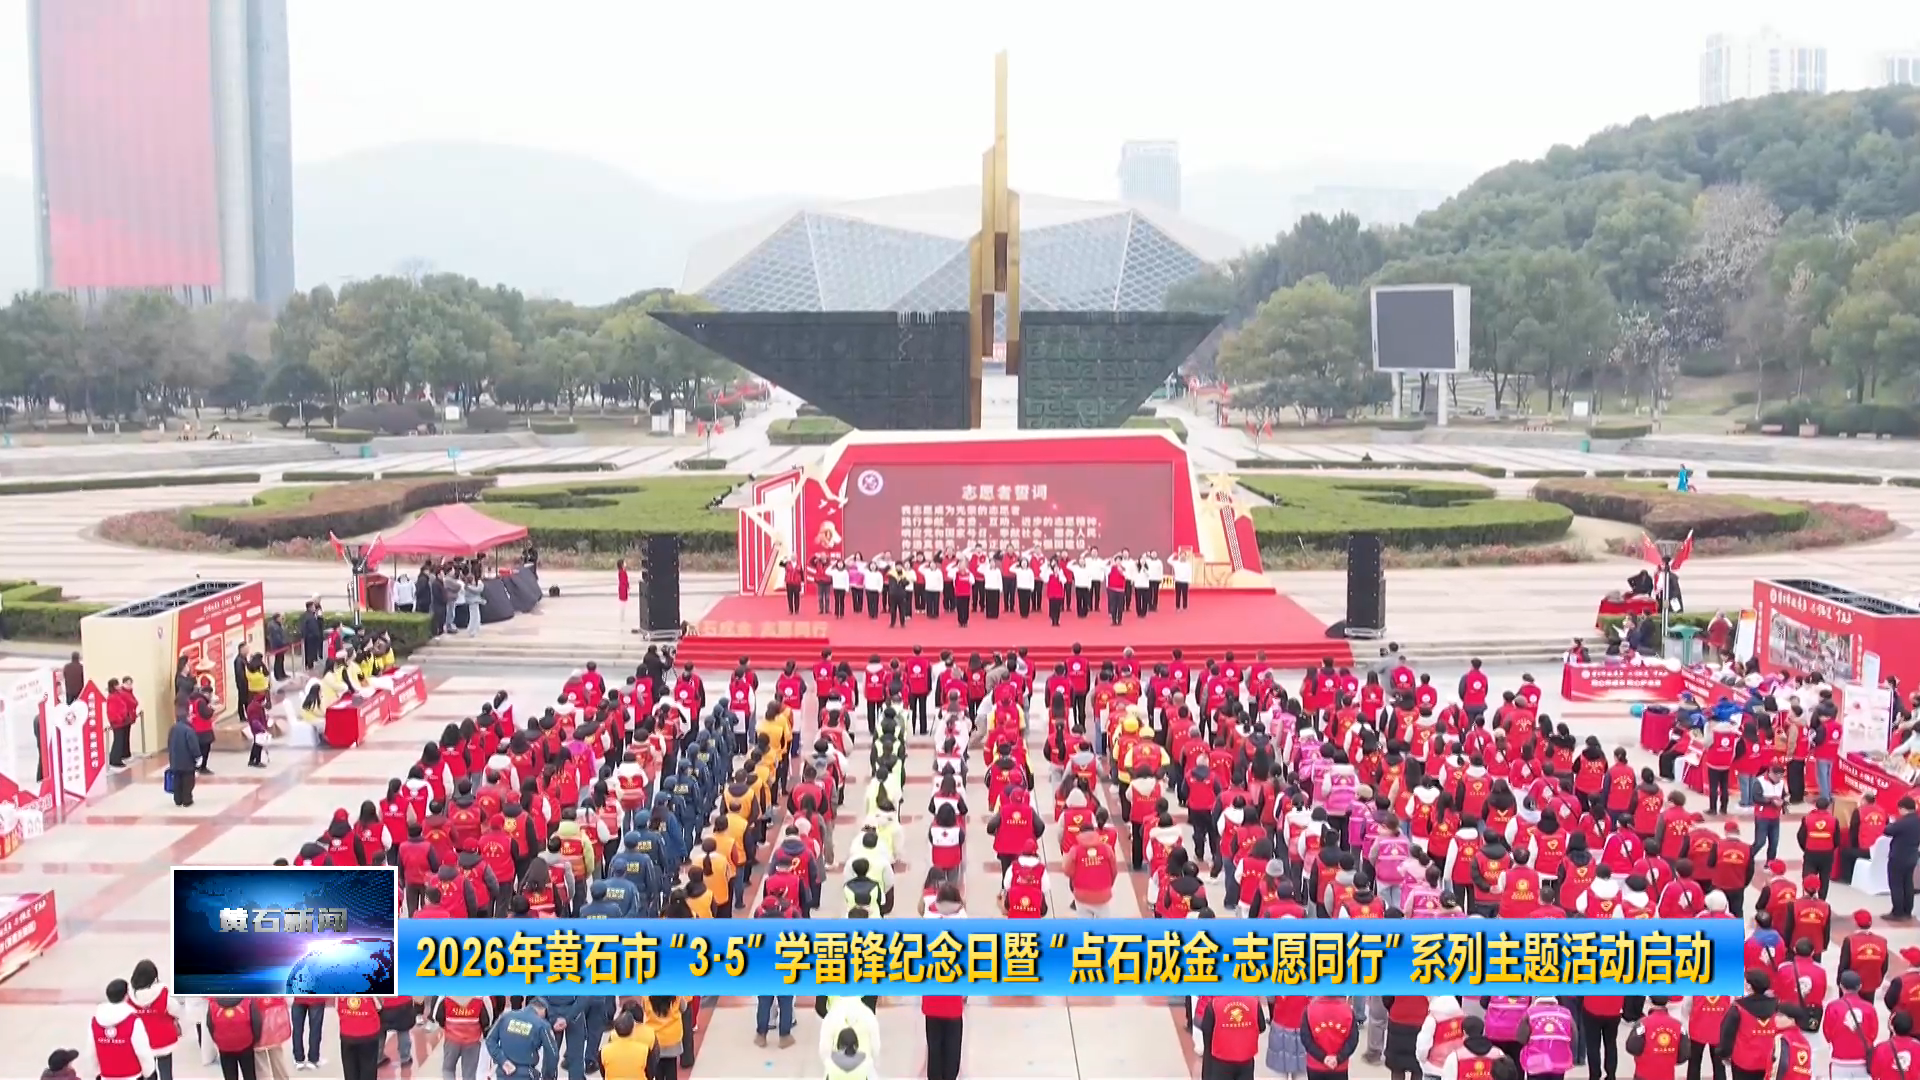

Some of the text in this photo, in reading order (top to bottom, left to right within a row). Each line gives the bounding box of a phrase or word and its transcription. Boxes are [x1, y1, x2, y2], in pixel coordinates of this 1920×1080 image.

[962, 484, 1048, 501] 志愿者誓词
